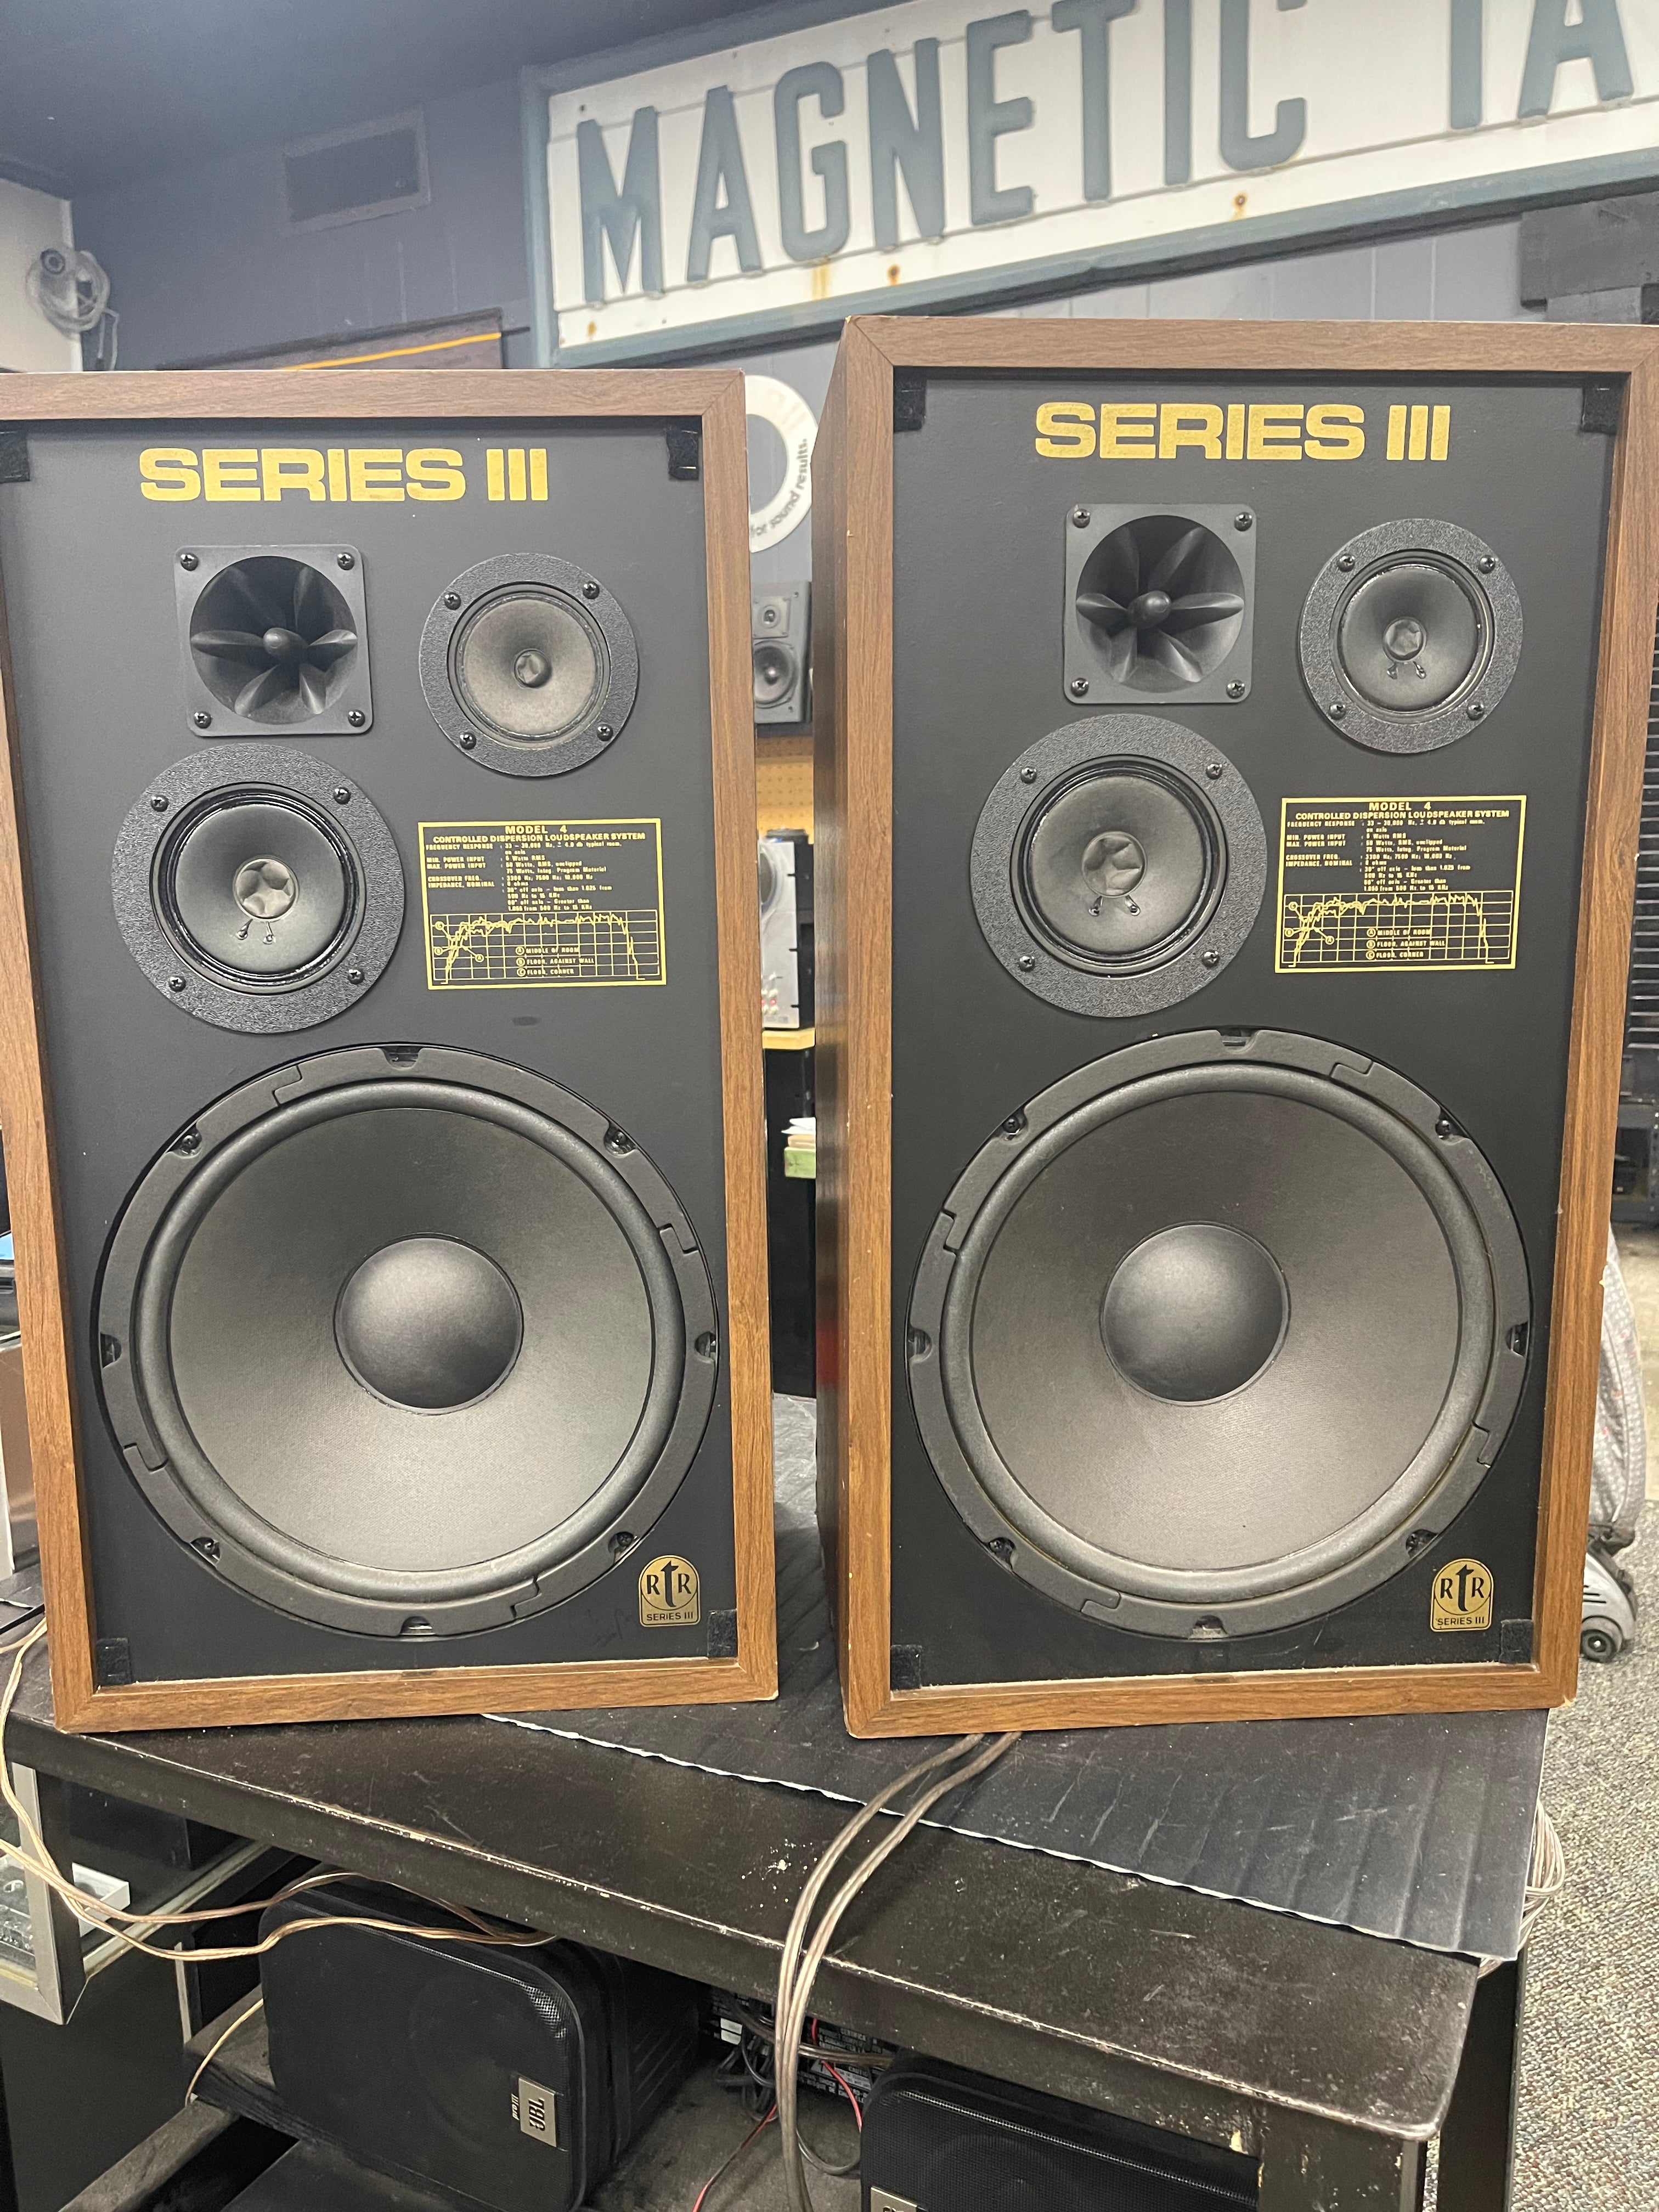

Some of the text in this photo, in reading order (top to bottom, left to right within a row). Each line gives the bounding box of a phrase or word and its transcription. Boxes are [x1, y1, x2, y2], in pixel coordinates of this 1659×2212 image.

[578, 0, 1307, 306] MAGNETIC
[1035, 402, 1451, 461] SERIES III
[139, 447, 548, 501] SERIES III
[770, 490, 800, 529] sound
[1369, 802, 1431, 811] MODEL 4
[505, 825, 567, 834] MODEL 4
[646, 1560, 691, 1607] RTR
[1440, 1564, 1485, 1611] RTR
[646, 1612, 681, 1621] SERIES
[1437, 1617, 1472, 1626] SERIES
[528, 2097, 546, 2131] JBL
